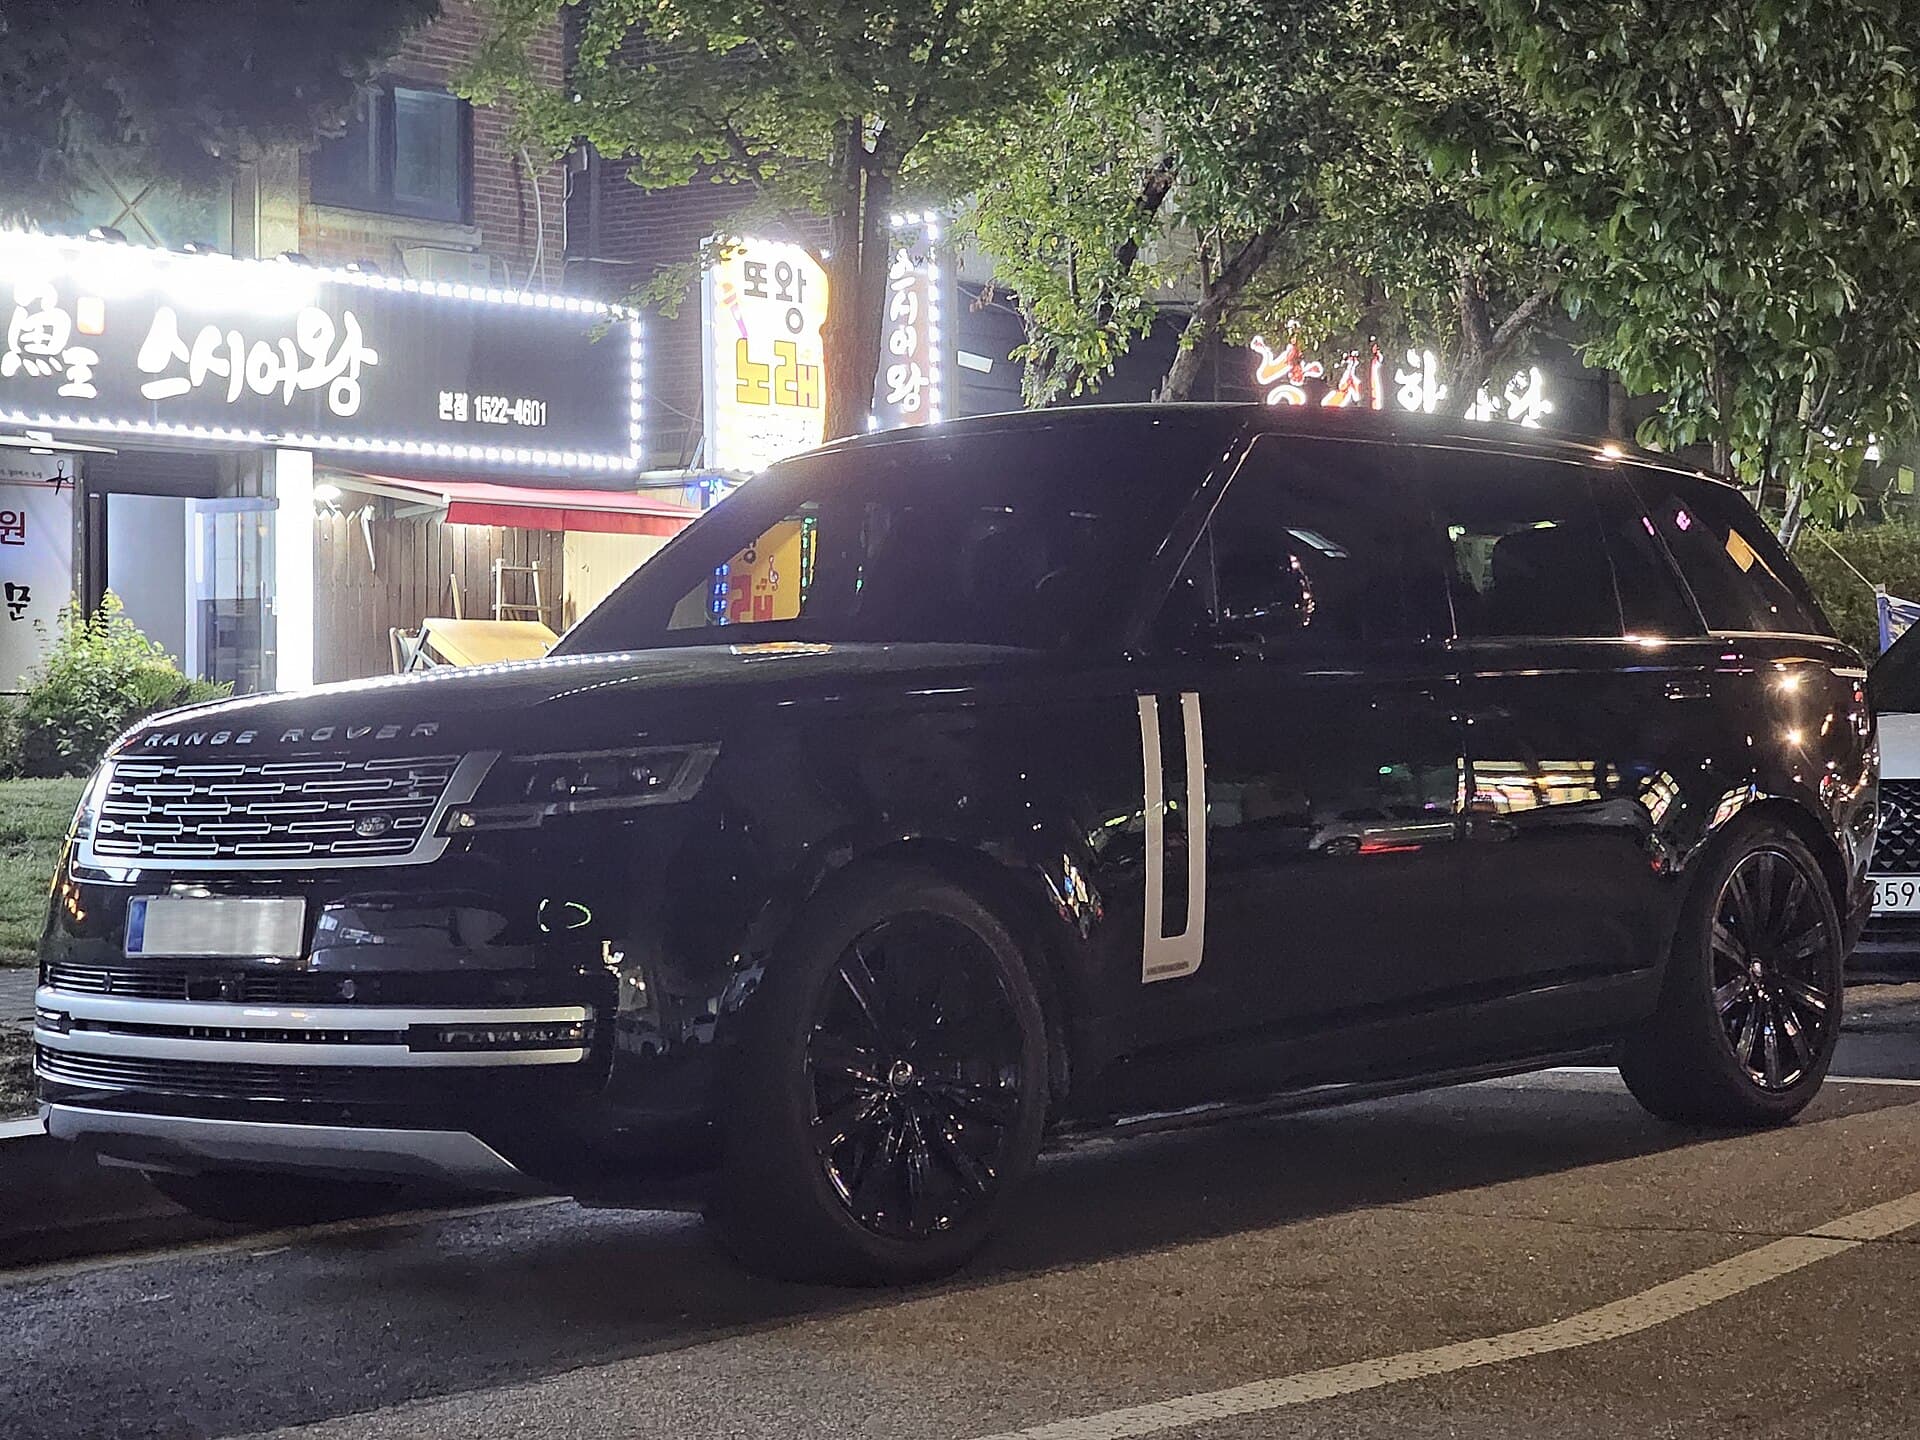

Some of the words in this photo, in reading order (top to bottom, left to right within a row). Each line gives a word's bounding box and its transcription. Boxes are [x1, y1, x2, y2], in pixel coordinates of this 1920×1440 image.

[744, 261, 806, 334] 또왕
[137, 306, 379, 417] 스시어왕
[736, 338, 819, 408] 노래
[474, 395, 547, 426] 1522-4601
[144, 731, 258, 747] RANGE
[280, 723, 440, 742] ROVER
